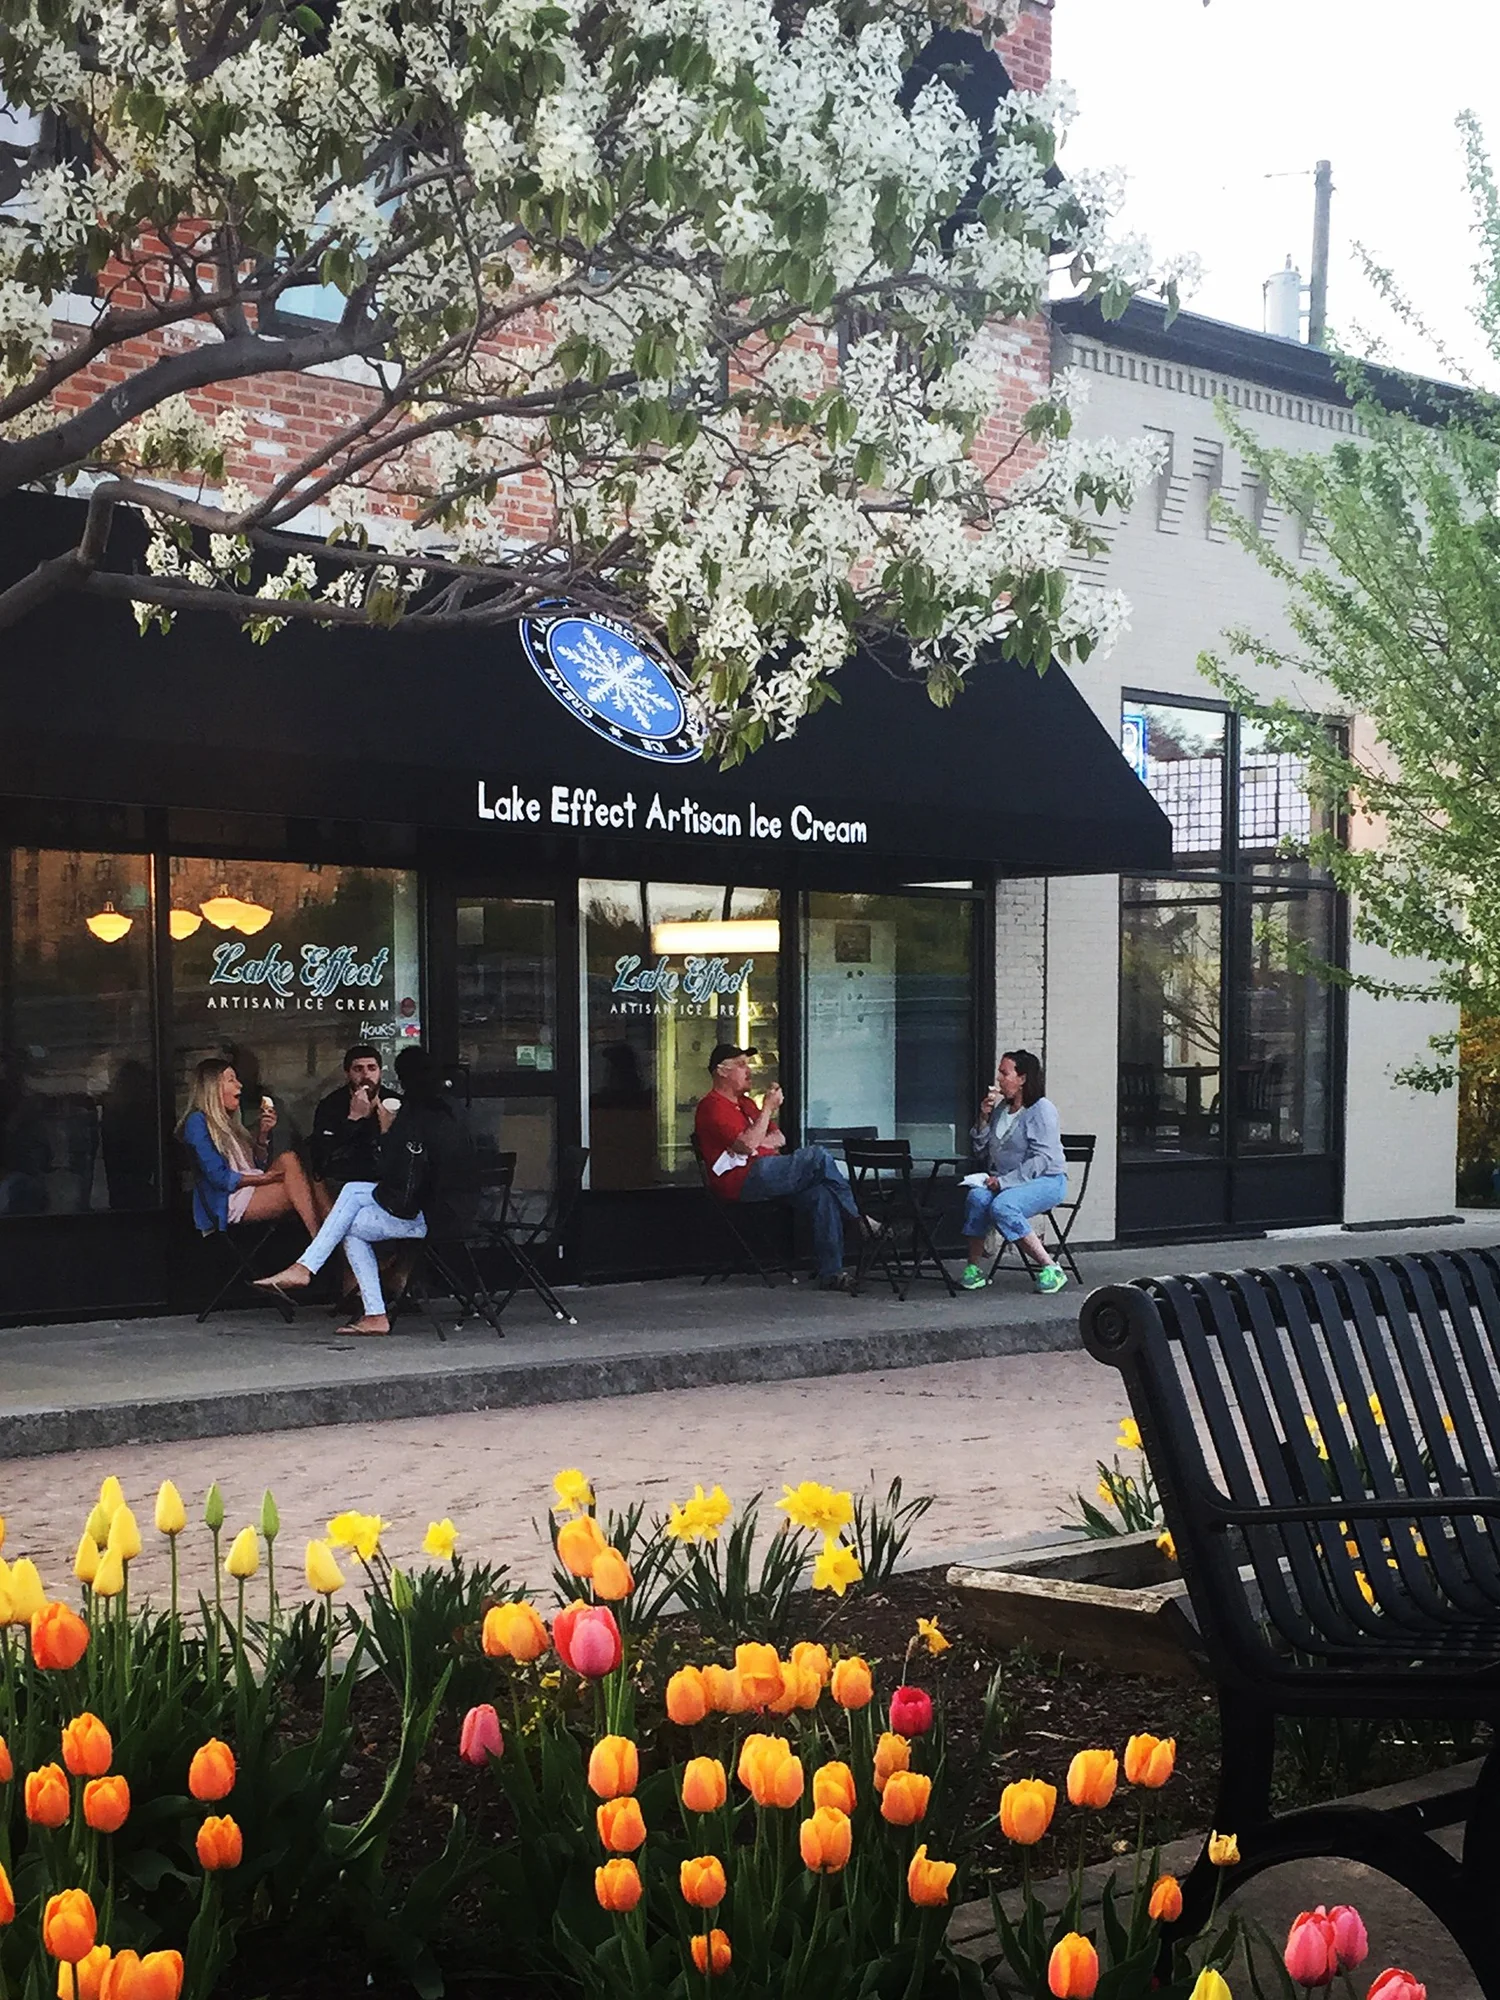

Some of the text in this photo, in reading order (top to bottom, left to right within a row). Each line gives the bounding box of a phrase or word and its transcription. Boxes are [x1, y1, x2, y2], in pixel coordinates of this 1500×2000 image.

[478, 780, 867, 844] Lake Effect Artisan Ice Cream
[209, 942, 390, 998] Lake Effect
[612, 954, 754, 1004] Lake Effect
[207, 996, 390, 1011] ARTISAN ICE CREAM
[610, 1002, 671, 1015] ARTISAN
[680, 1003, 702, 1015] ICE
